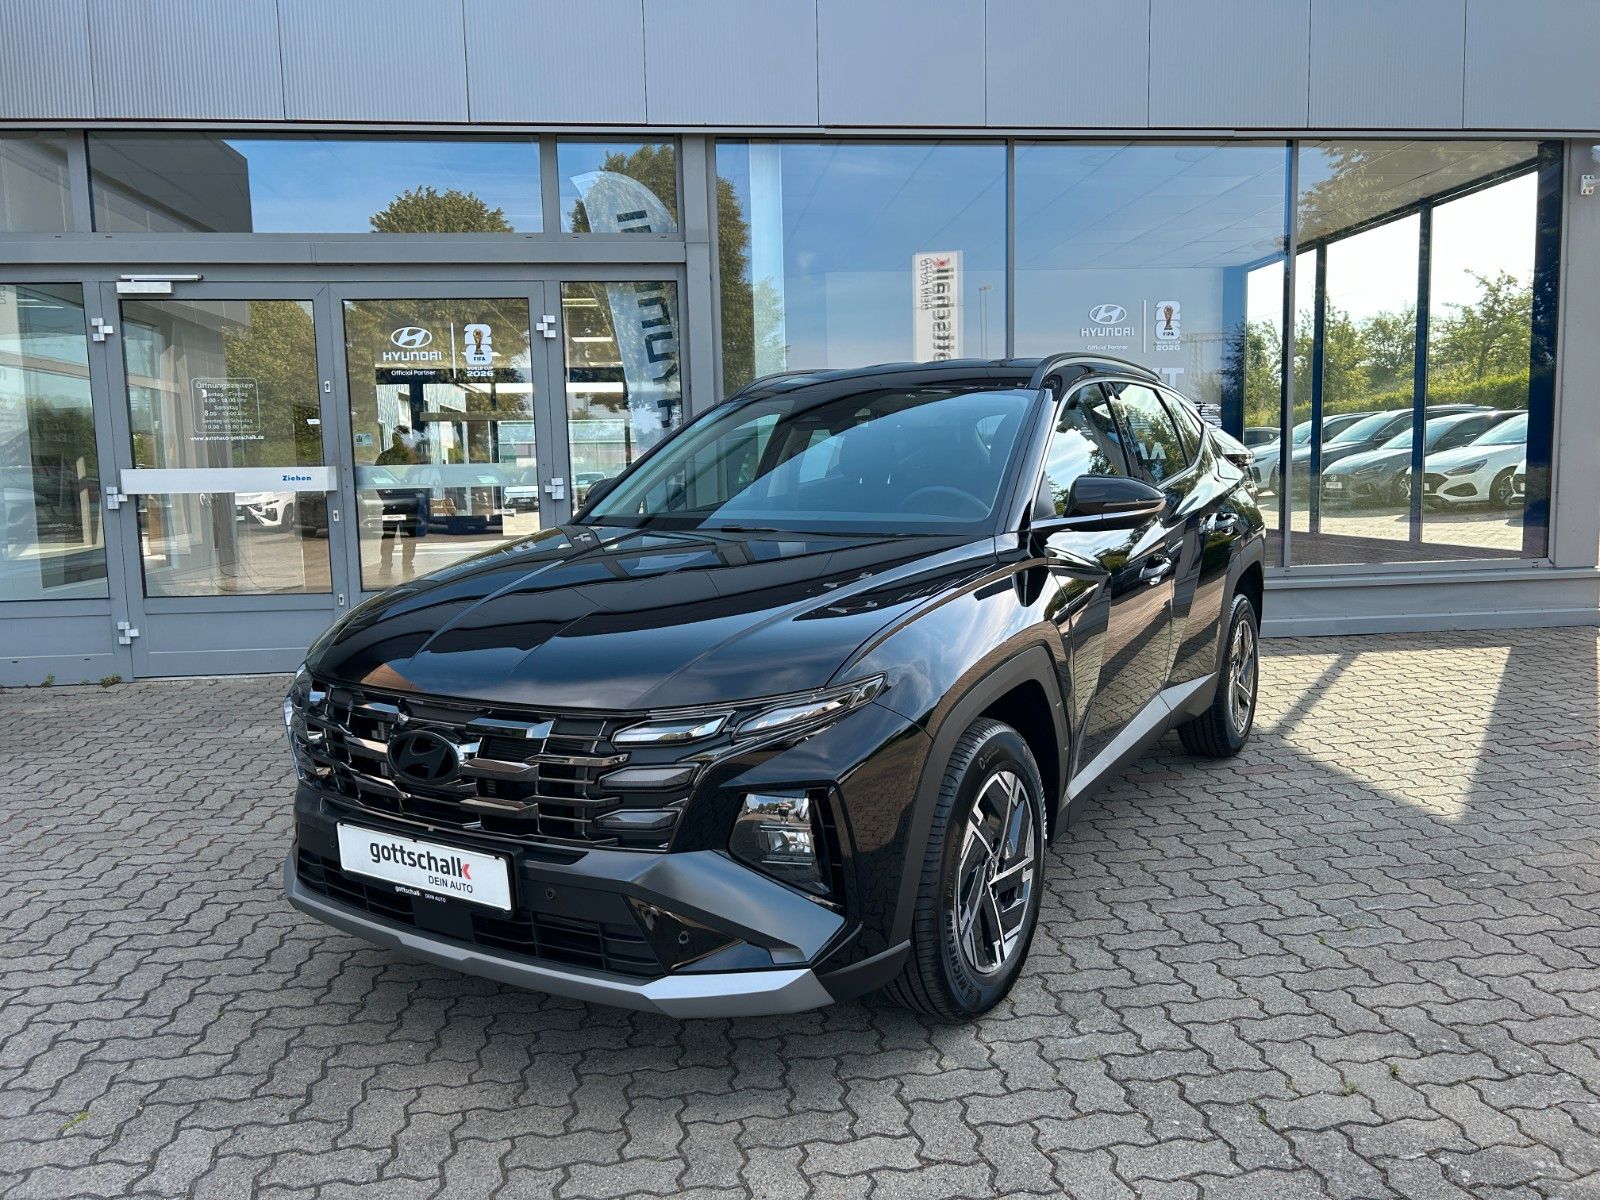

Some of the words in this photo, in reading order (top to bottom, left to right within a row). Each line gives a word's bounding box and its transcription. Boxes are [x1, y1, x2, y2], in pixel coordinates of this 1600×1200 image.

[1080, 326, 1135, 337] HYUNDAI
[382, 351, 442, 361] HYUNDAI
[369, 842, 472, 880] gottschalk
[428, 875, 448, 888] DEIN
[449, 880, 474, 894] AUTO
[424, 892, 434, 900] DEIN
[946, 913, 969, 991] MICHELIN
